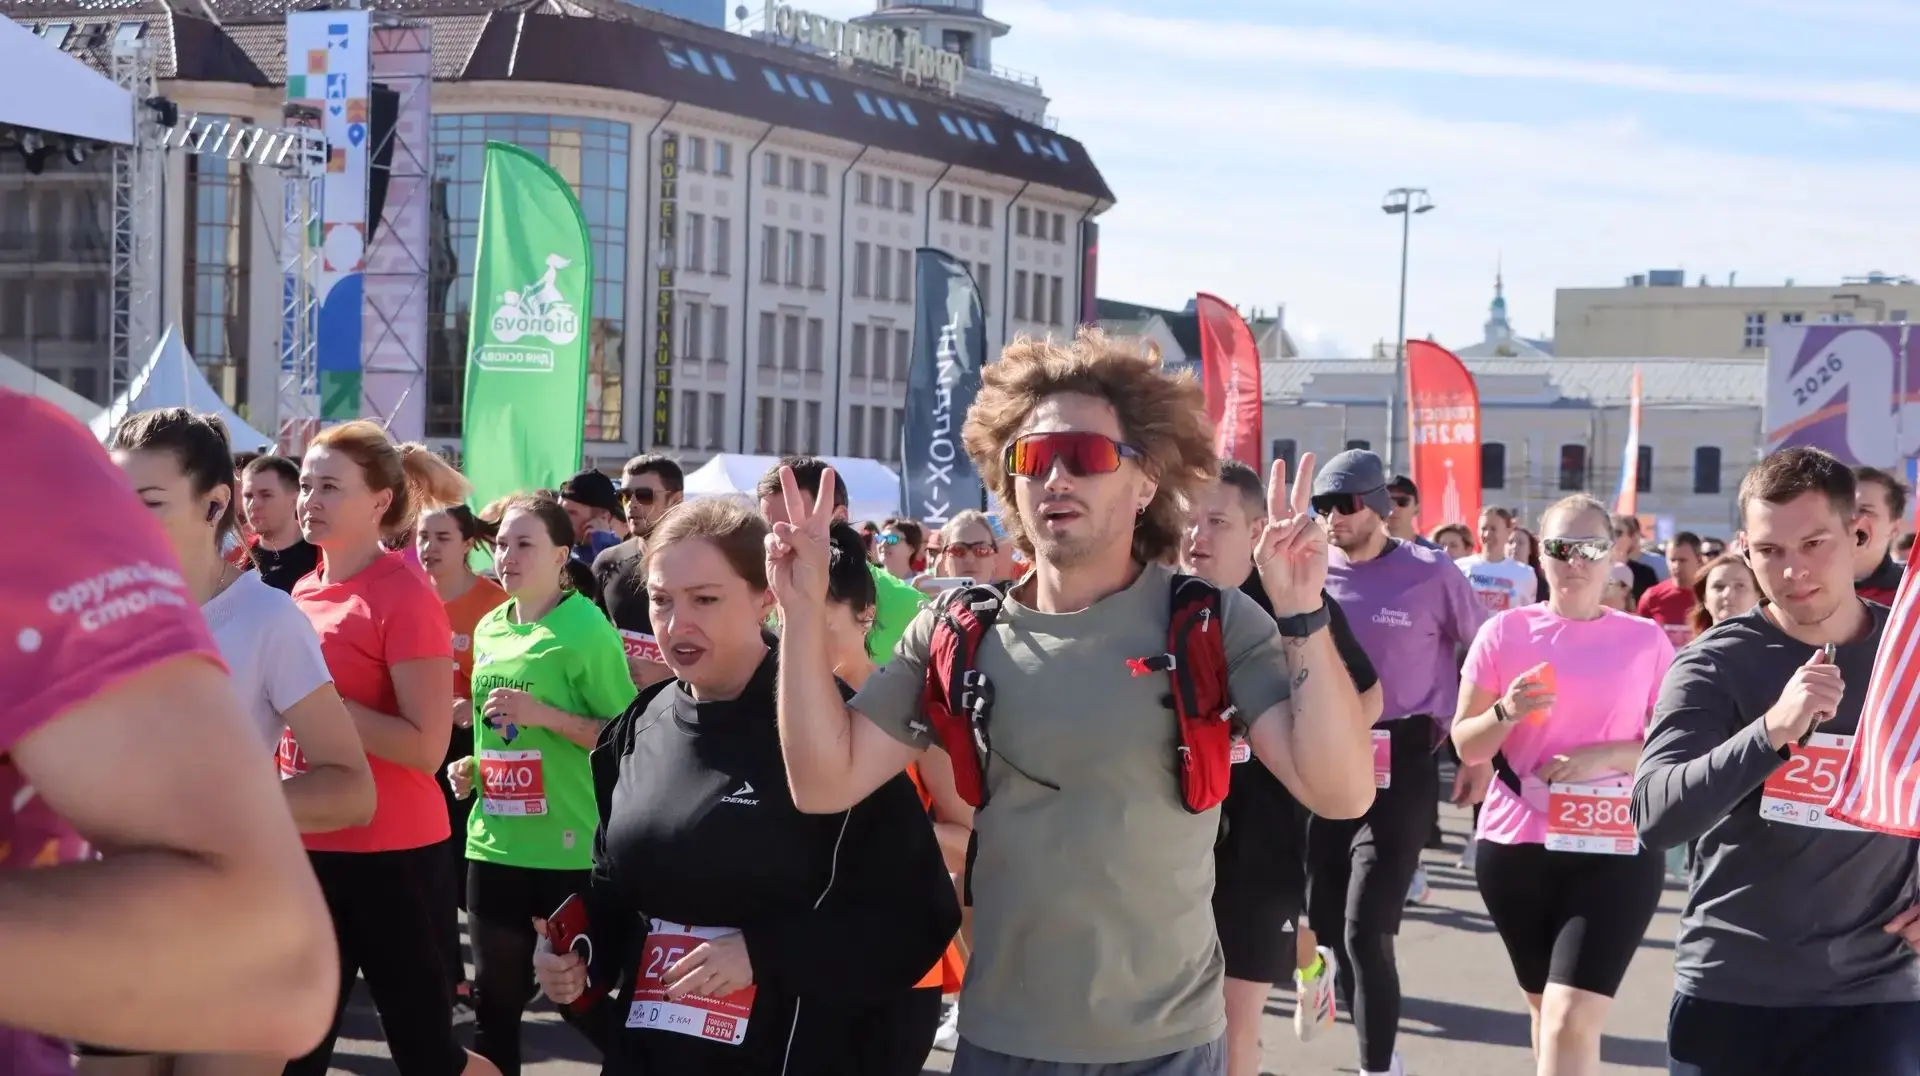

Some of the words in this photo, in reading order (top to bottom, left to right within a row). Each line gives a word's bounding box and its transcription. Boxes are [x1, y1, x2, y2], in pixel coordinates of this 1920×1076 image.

[660, 139, 677, 238] HOTEL
[1793, 352, 1843, 406] 2026
[485, 766, 533, 791] 2440
[720, 796, 760, 806] DEMIX
[1559, 800, 1631, 828] 2380
[1809, 808, 1820, 822] D
[649, 1007, 659, 1022] D
